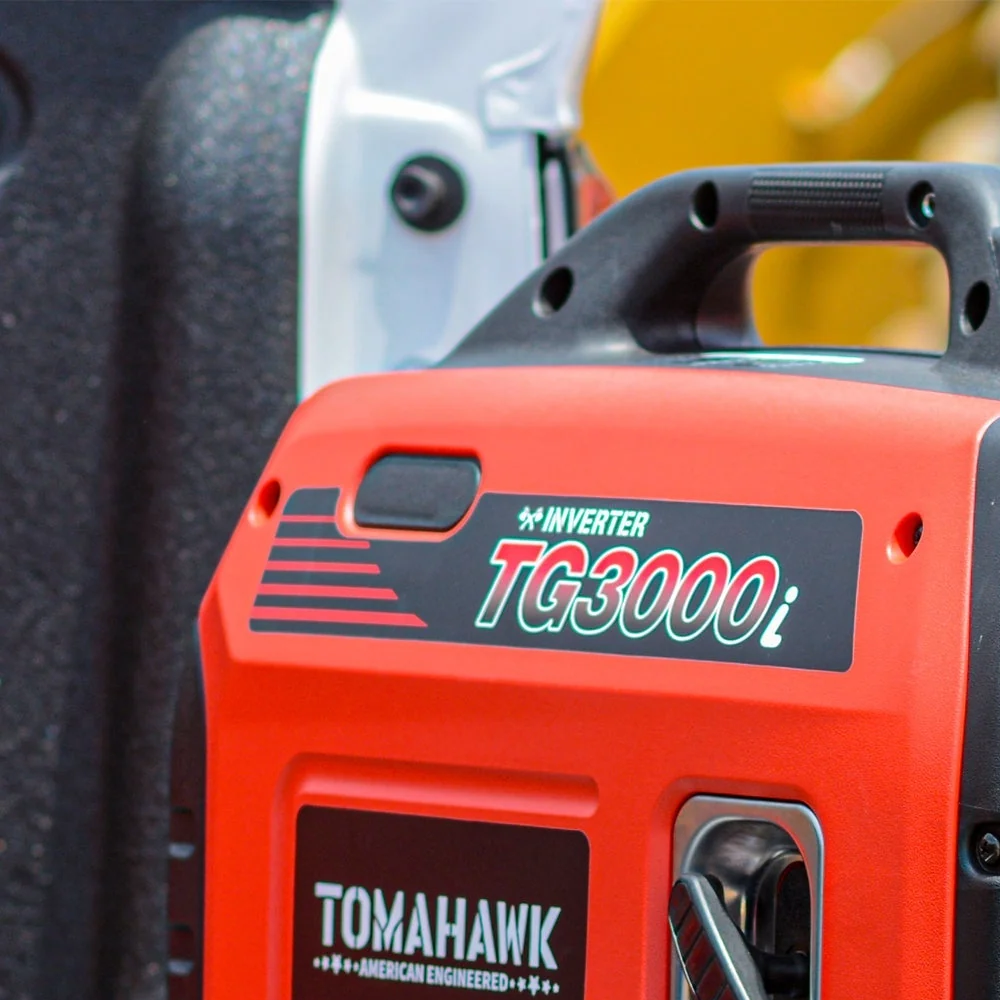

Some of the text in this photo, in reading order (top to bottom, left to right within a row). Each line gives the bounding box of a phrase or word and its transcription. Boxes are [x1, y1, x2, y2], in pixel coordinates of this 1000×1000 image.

[542, 506, 650, 539] INVERTER
[475, 539, 799, 649] TG3000i
[314, 881, 562, 970] TOMAHAWK
[358, 957, 509, 993] AMERICAN ENGINEERED
